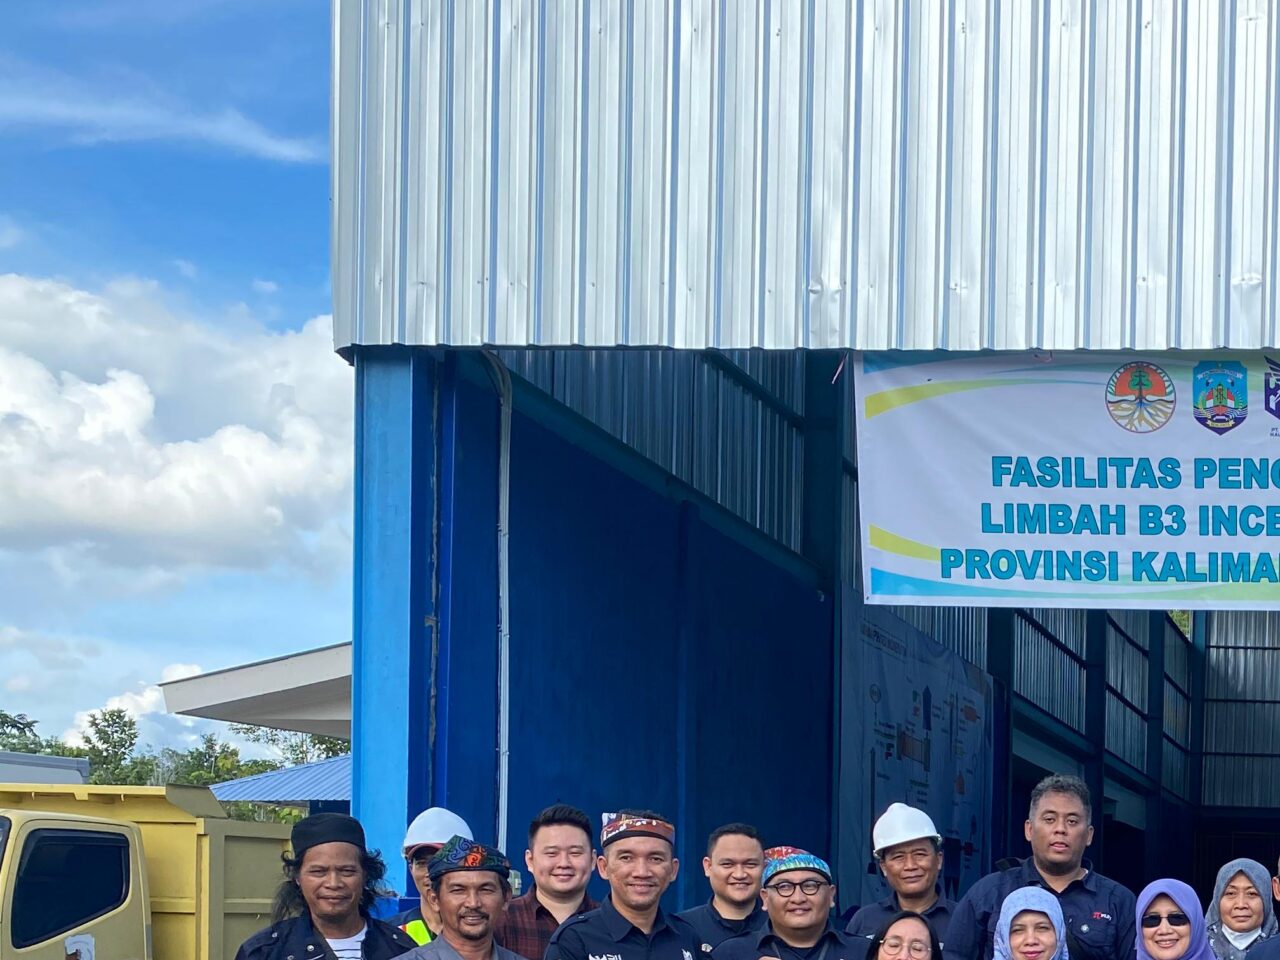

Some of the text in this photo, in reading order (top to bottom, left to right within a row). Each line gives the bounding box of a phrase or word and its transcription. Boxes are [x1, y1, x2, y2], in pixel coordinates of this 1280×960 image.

[992, 456, 1181, 489] FASILITAS
[981, 503, 1125, 535] LIMBAH
[1139, 505, 1186, 536] B3
[940, 549, 1118, 581] PROVINSI
